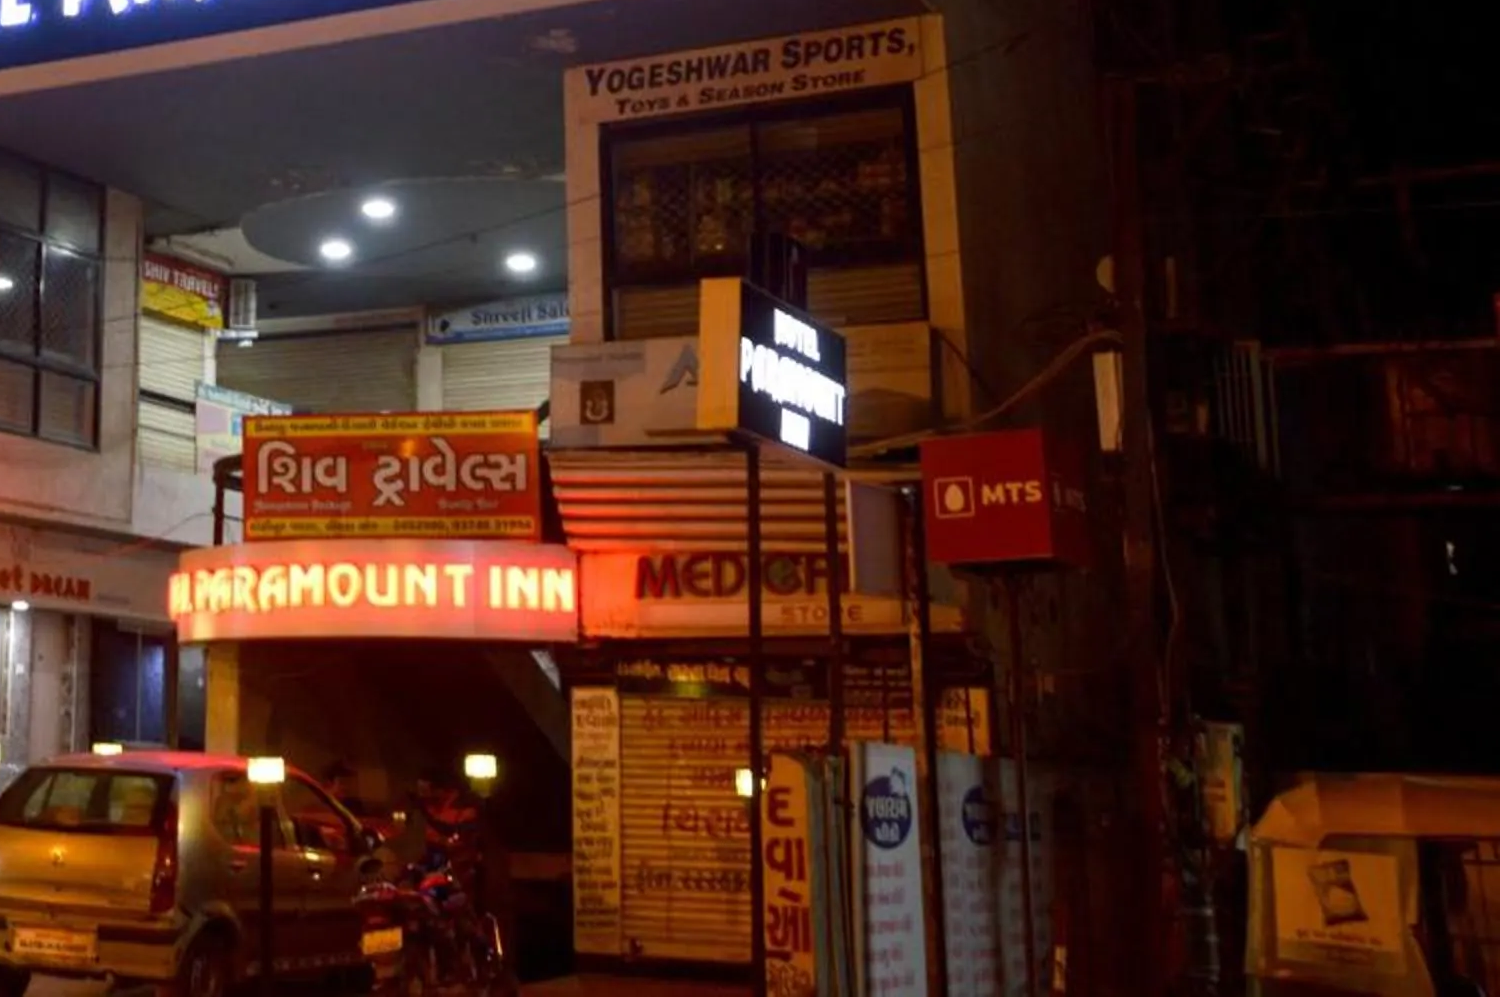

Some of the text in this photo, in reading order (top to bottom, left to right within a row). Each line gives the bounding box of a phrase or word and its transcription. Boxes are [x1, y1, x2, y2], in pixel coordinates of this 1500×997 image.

[585, 48, 770, 96] YOGESHWAR
[256, 439, 349, 495] શિવ
[981, 480, 1043, 506] MTS
[30, 570, 91, 600] DREAM
[194, 562, 474, 616] PARAMOUNT
[489, 565, 574, 614] INN
[780, 604, 863, 625] STOE
